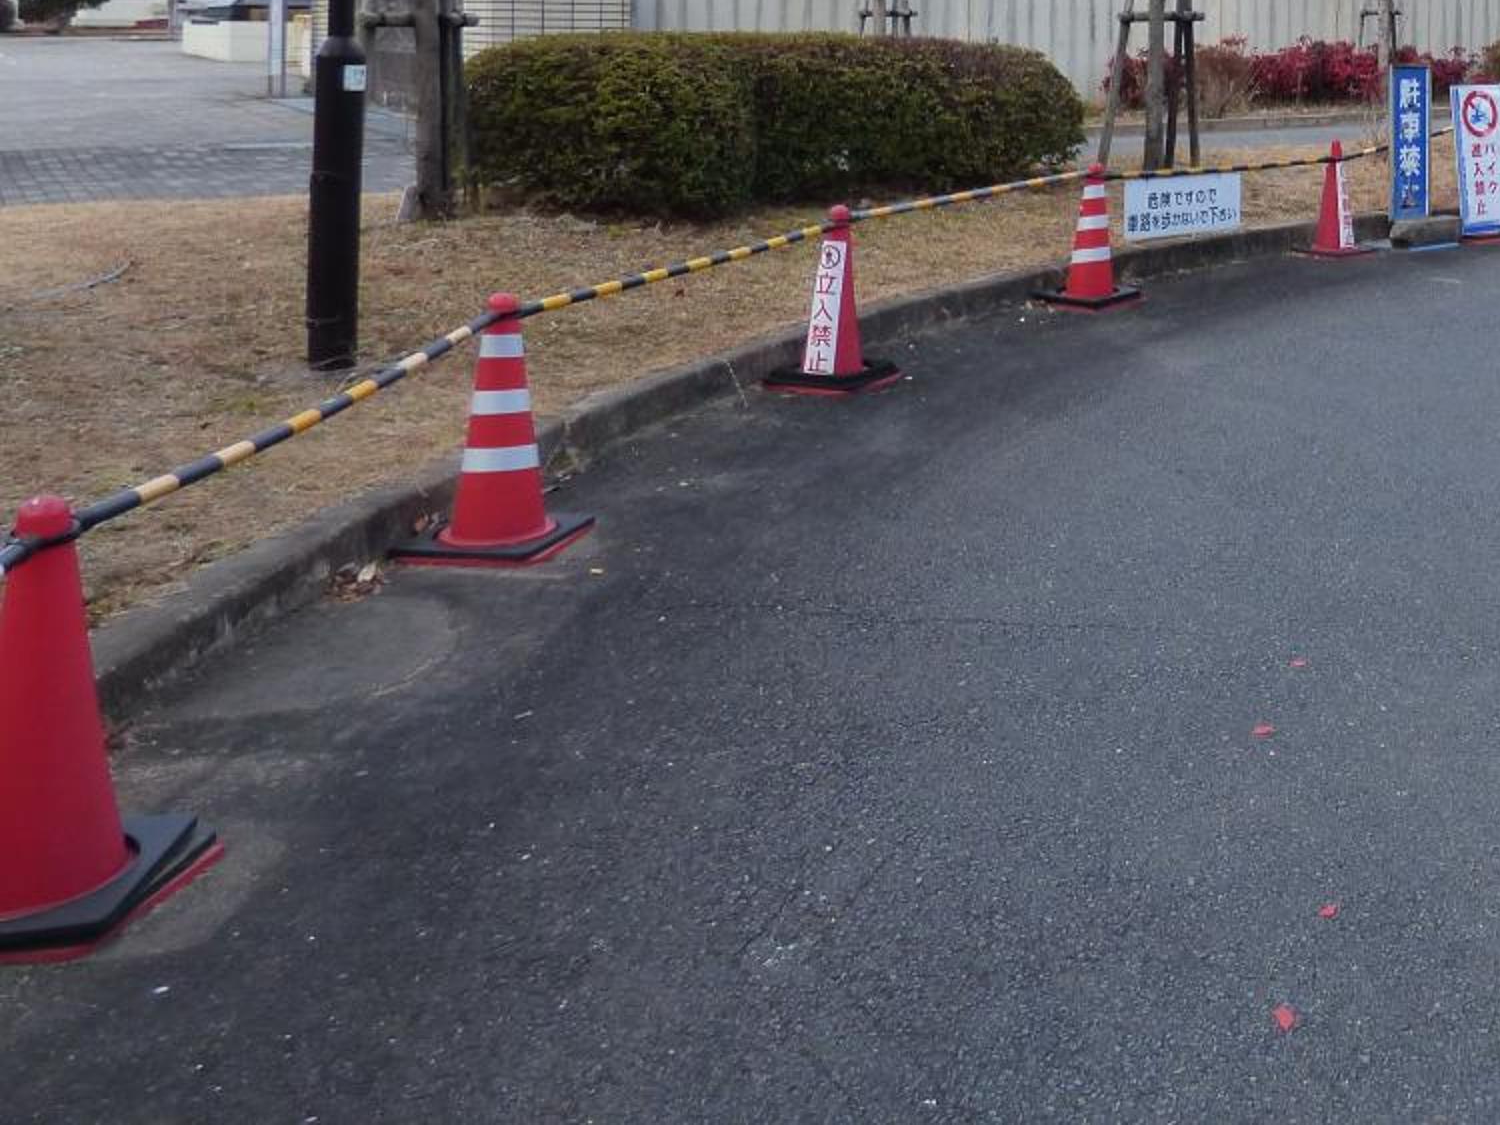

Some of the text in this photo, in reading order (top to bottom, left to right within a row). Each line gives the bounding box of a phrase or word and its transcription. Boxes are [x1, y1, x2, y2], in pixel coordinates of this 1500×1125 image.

[1147, 188, 1217, 210] 危険ですので
[808, 272, 838, 374] 立入禁止
